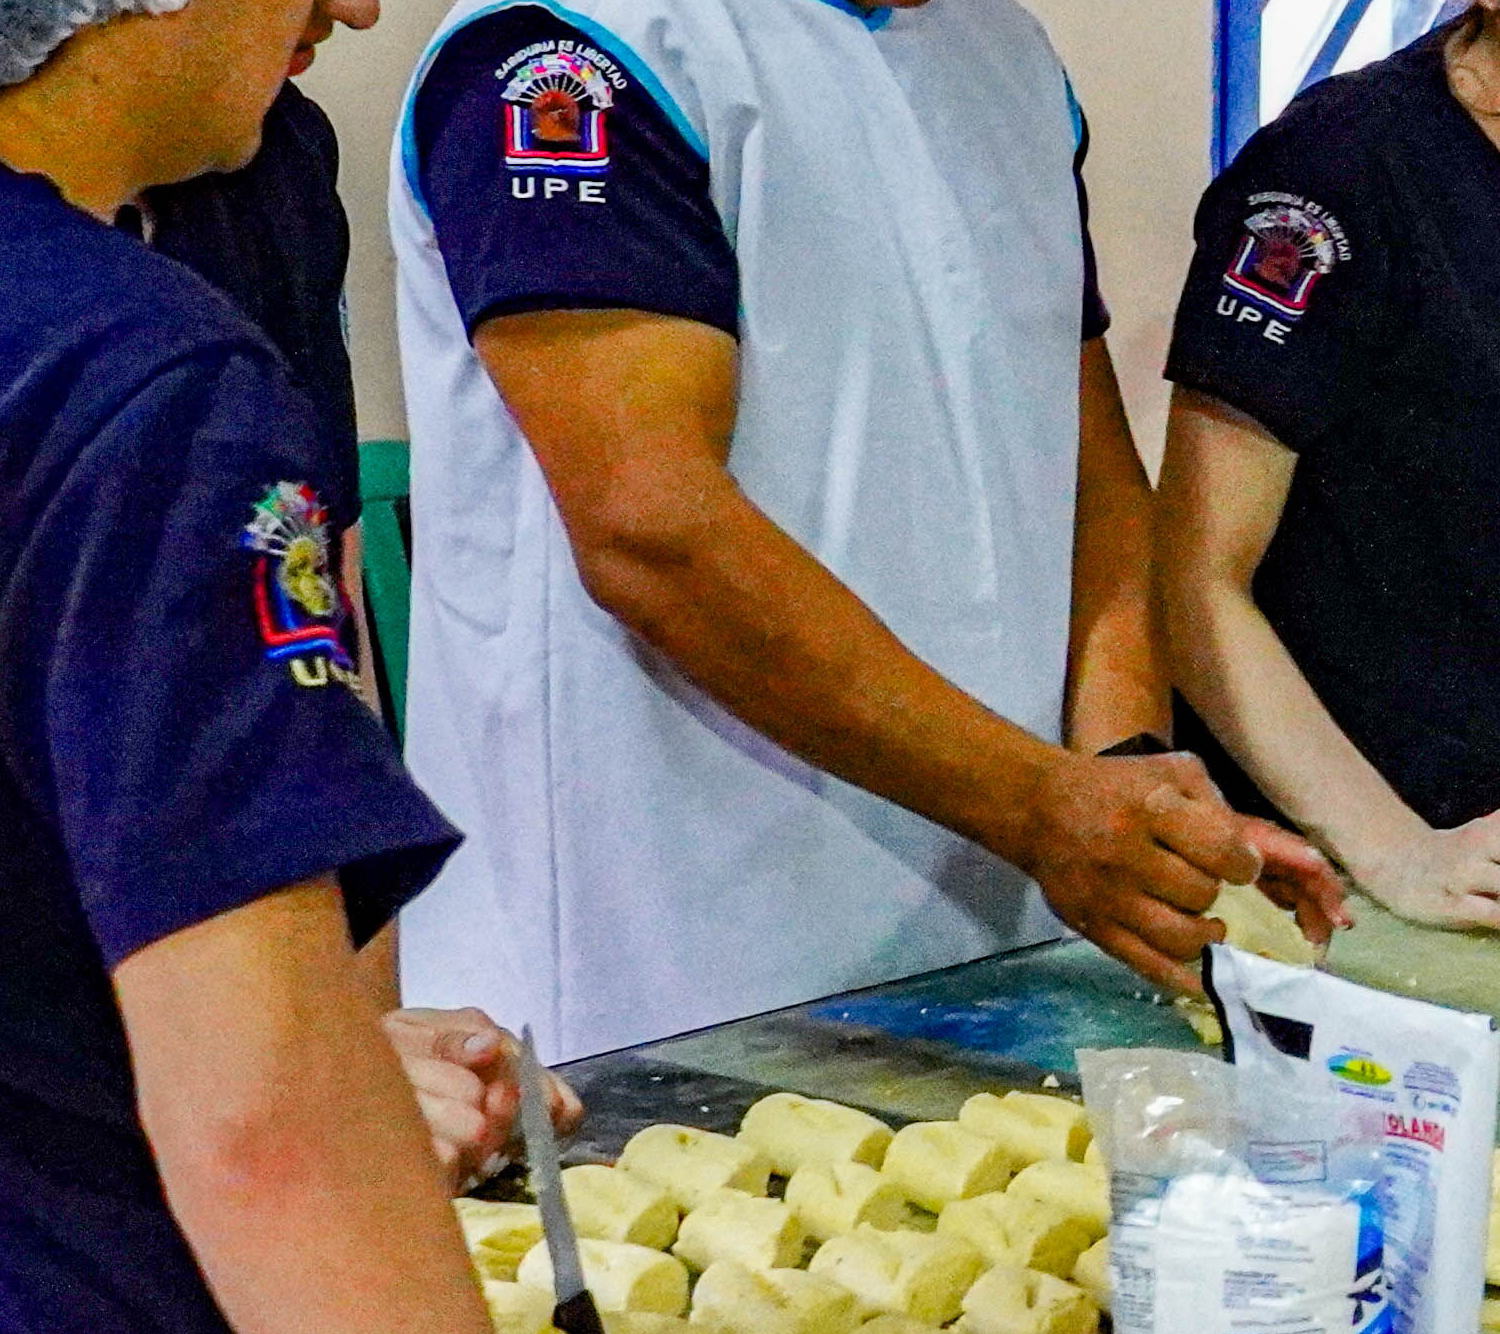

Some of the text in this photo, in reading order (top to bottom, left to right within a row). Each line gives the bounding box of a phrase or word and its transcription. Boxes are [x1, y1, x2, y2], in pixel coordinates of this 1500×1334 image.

[557, 40, 575, 52] ES
[511, 176, 607, 204] UPE
[1216, 295, 1292, 345] UPE
